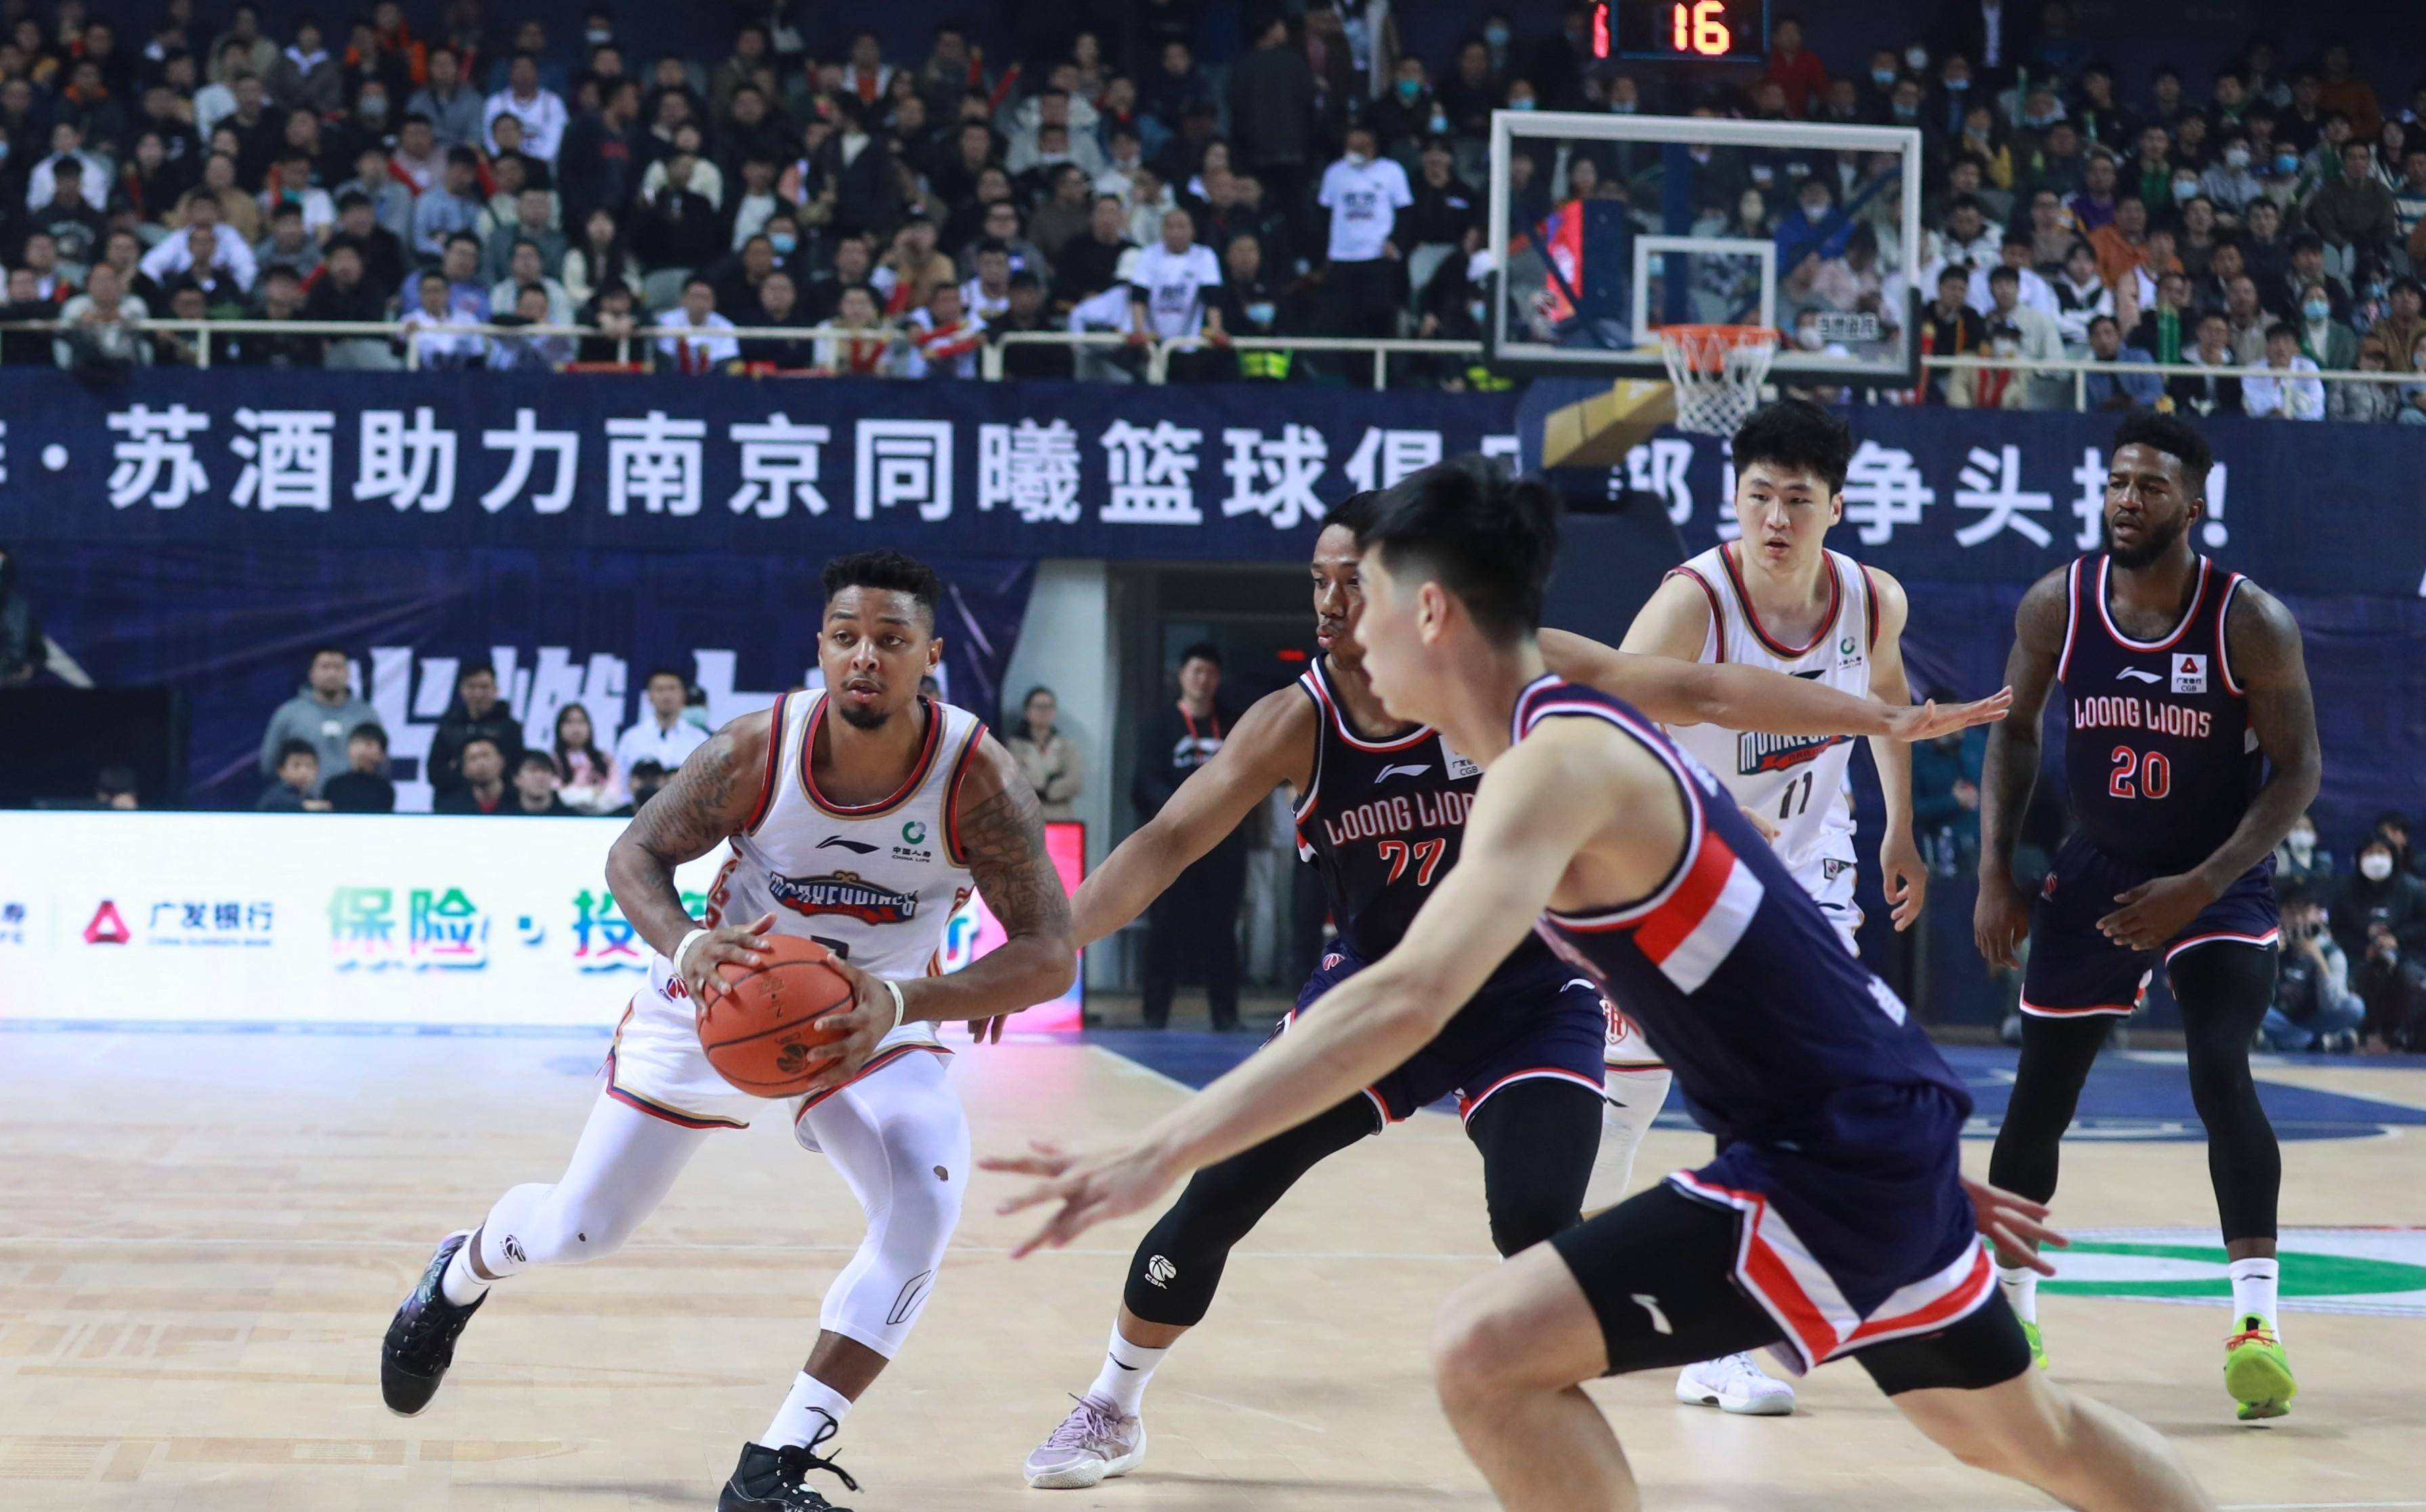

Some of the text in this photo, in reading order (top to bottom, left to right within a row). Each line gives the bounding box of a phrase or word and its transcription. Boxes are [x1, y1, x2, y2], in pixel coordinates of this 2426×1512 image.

[1674, 0, 1731, 56] 16
[2074, 695, 2212, 738] LOONG LIONS
[1460, 765, 1479, 777] CGB
[2108, 745, 2171, 799] 20
[1779, 771, 1813, 820] 11
[1324, 796, 1414, 846] LOONG
[1378, 838, 1446, 886] 77
[149, 901, 274, 930] 广发银行
